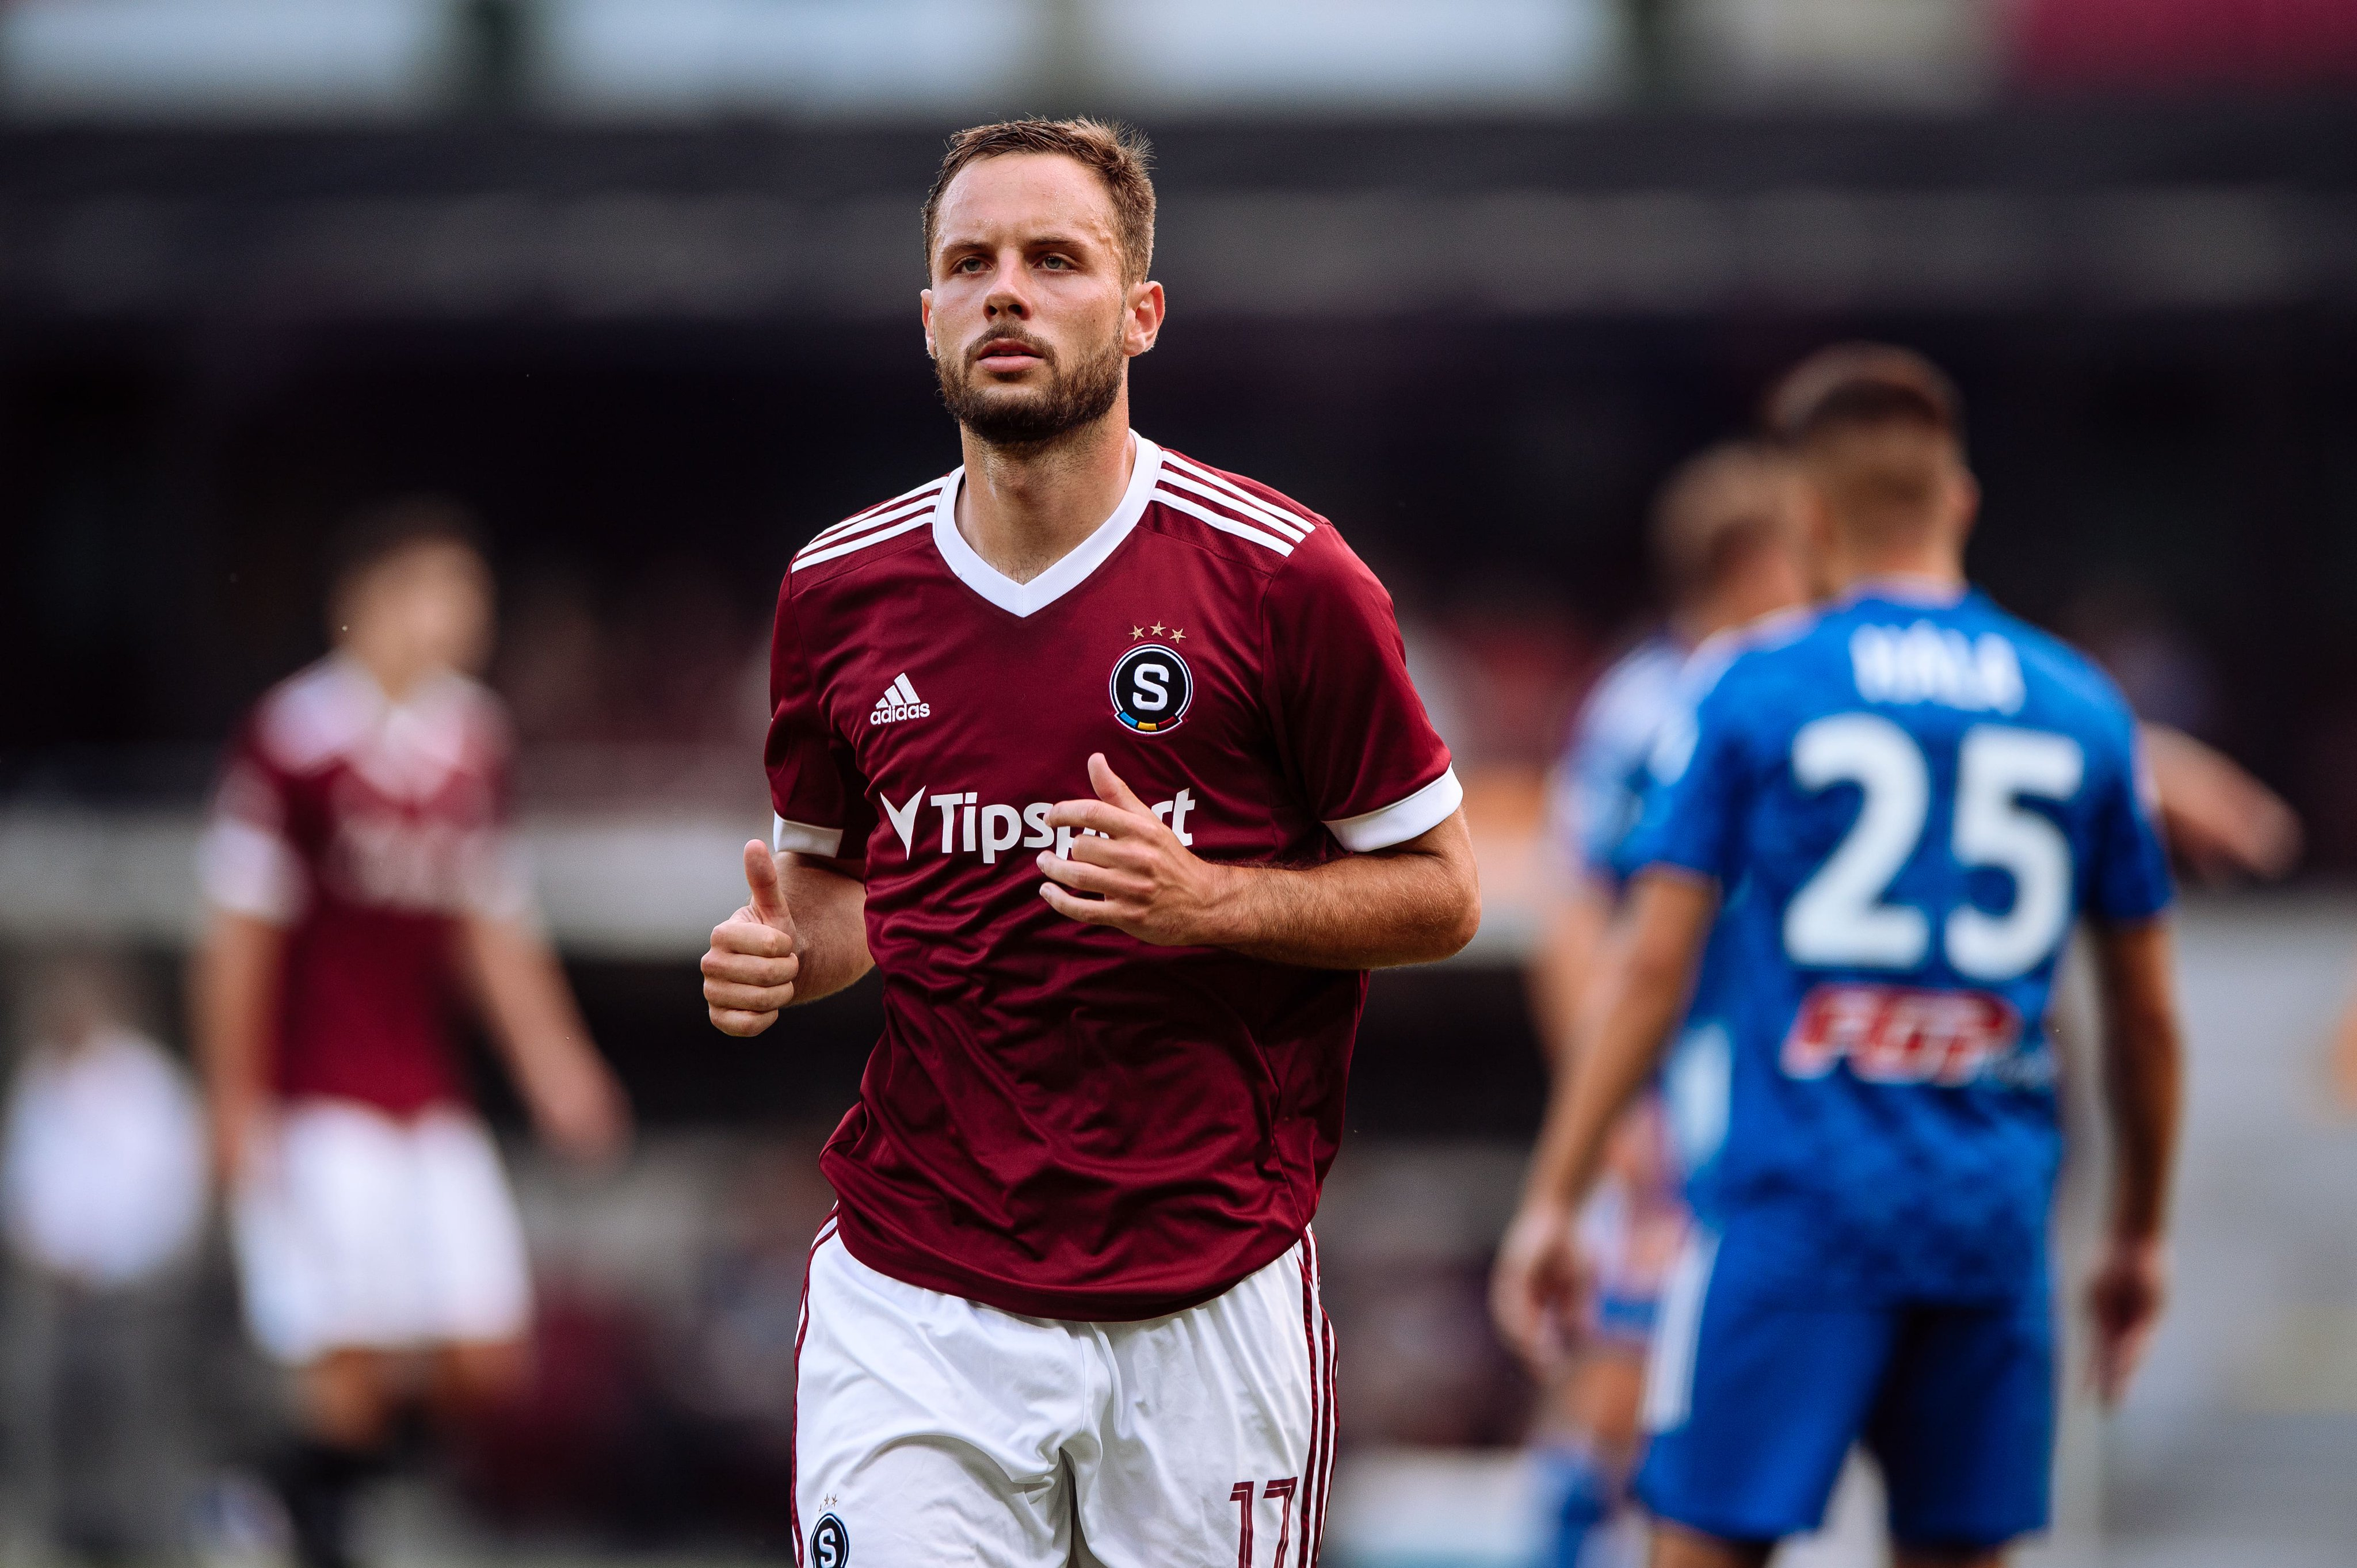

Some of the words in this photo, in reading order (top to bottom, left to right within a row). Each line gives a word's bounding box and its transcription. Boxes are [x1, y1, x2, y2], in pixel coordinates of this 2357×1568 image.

[1132, 663, 1169, 711] S
[870, 702, 930, 725] adidas
[1786, 711, 2083, 979] 25
[1229, 1477, 1298, 1568] 17
[819, 1528, 837, 1568] S
